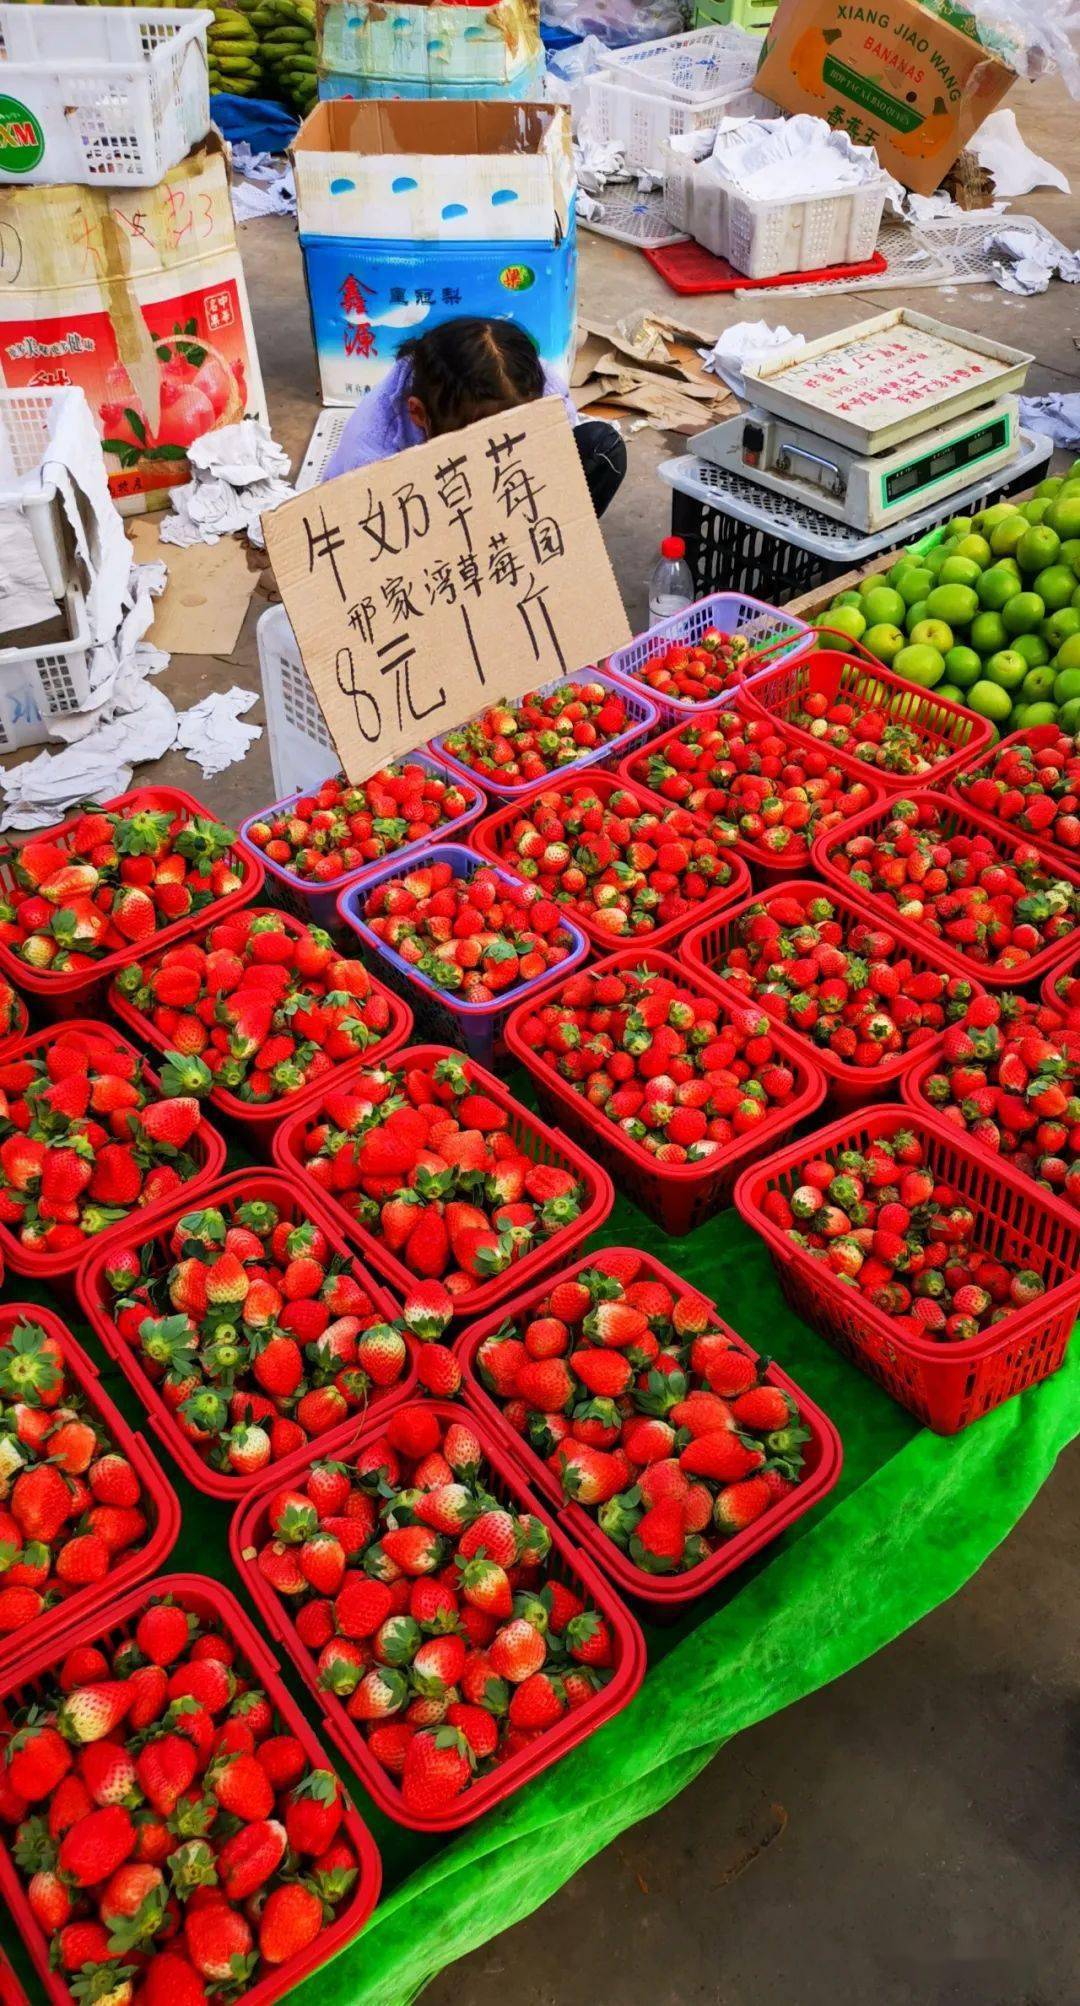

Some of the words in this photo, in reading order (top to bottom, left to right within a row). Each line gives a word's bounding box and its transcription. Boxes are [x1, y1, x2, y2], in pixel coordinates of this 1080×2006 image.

[838, 5, 890, 28] XIANG
[893, 23, 930, 52] JIAO
[928, 51, 961, 102] WANG
[863, 36, 925, 84] BANANAS
[827, 105, 880, 146] 香蕉王
[340, 273, 378, 358] 鑫源
[389, 287, 462, 305] 皇冠梨
[302, 431, 546, 602] 牛奶草莓
[347, 516, 565, 645] 邢家湾草莓园
